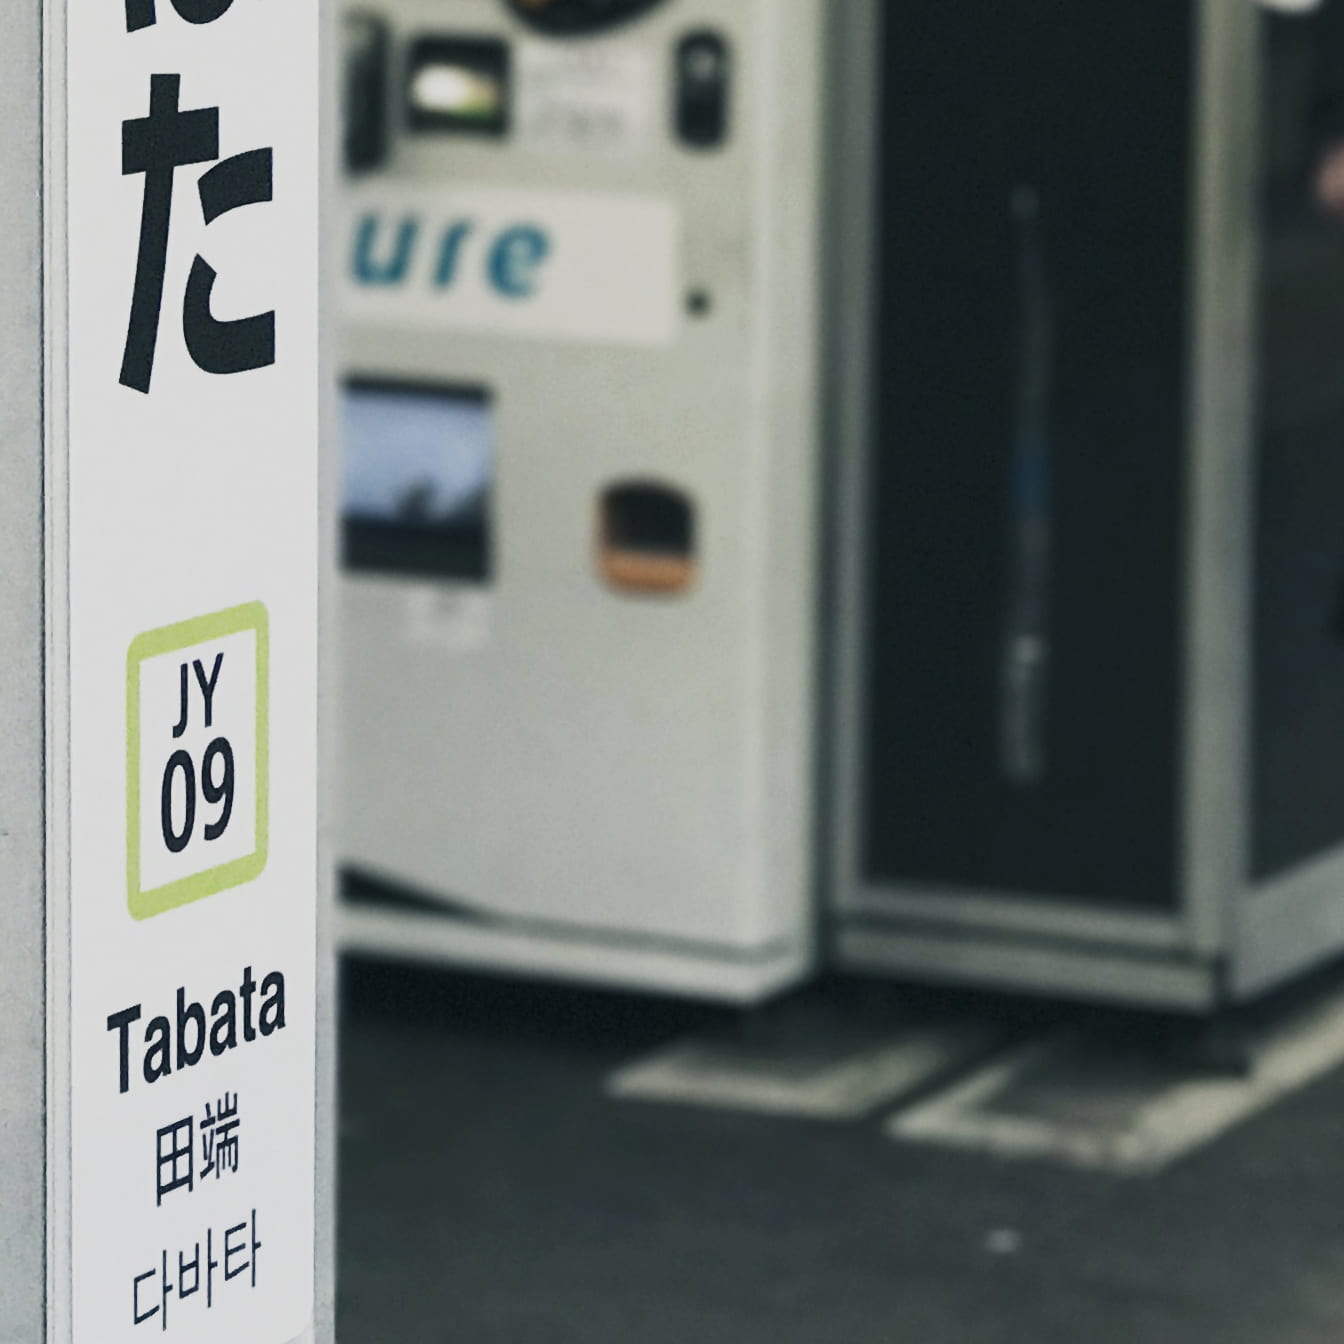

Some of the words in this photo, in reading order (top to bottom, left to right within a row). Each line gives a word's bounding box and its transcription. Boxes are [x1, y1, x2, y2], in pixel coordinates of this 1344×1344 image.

[172, 652, 226, 739] JY
[161, 736, 235, 853] 09
[107, 966, 287, 1094] Tabata
[156, 1090, 241, 1206] 田端
[133, 1208, 262, 1331] 다바타
